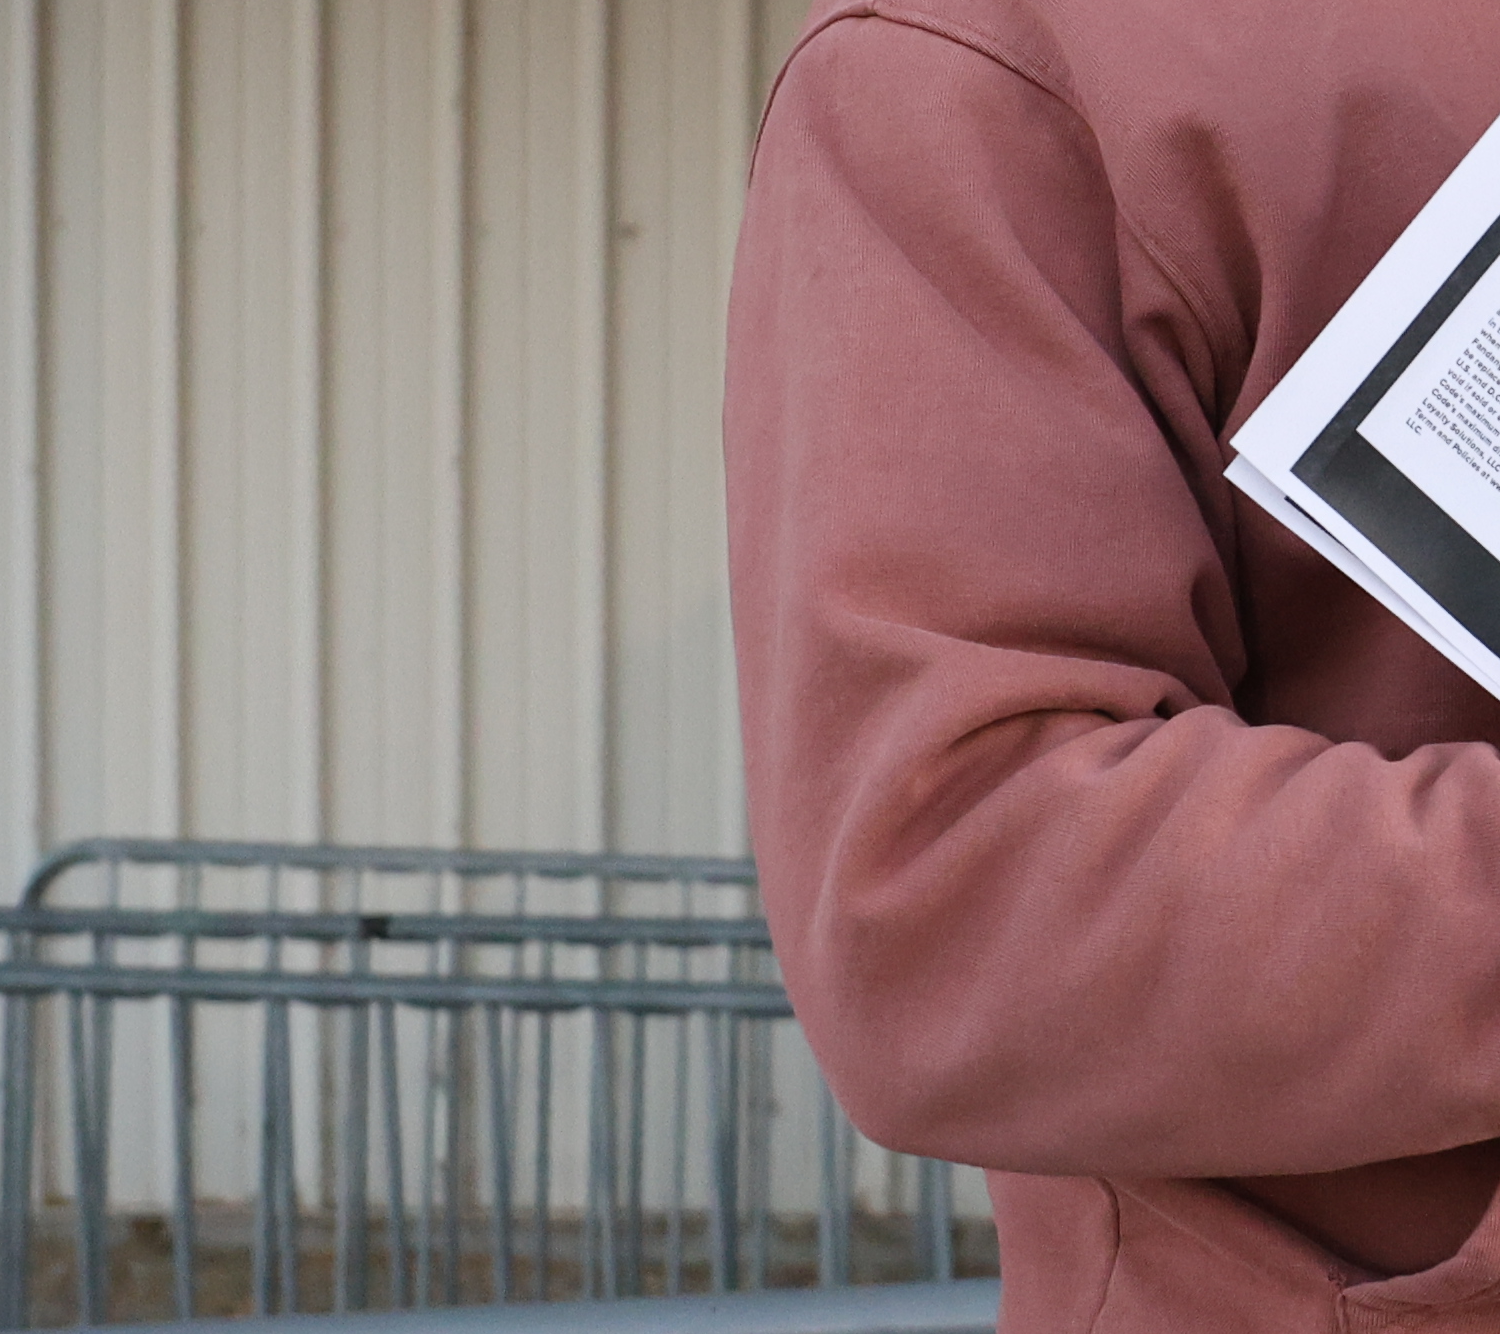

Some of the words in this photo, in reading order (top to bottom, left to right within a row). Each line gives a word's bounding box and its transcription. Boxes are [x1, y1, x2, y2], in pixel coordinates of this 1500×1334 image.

[1431, 388, 1456, 413] Code's
[1456, 412, 1492, 446] maximum
[1439, 378, 1464, 403] Code's
[1464, 402, 1500, 436] maximum
